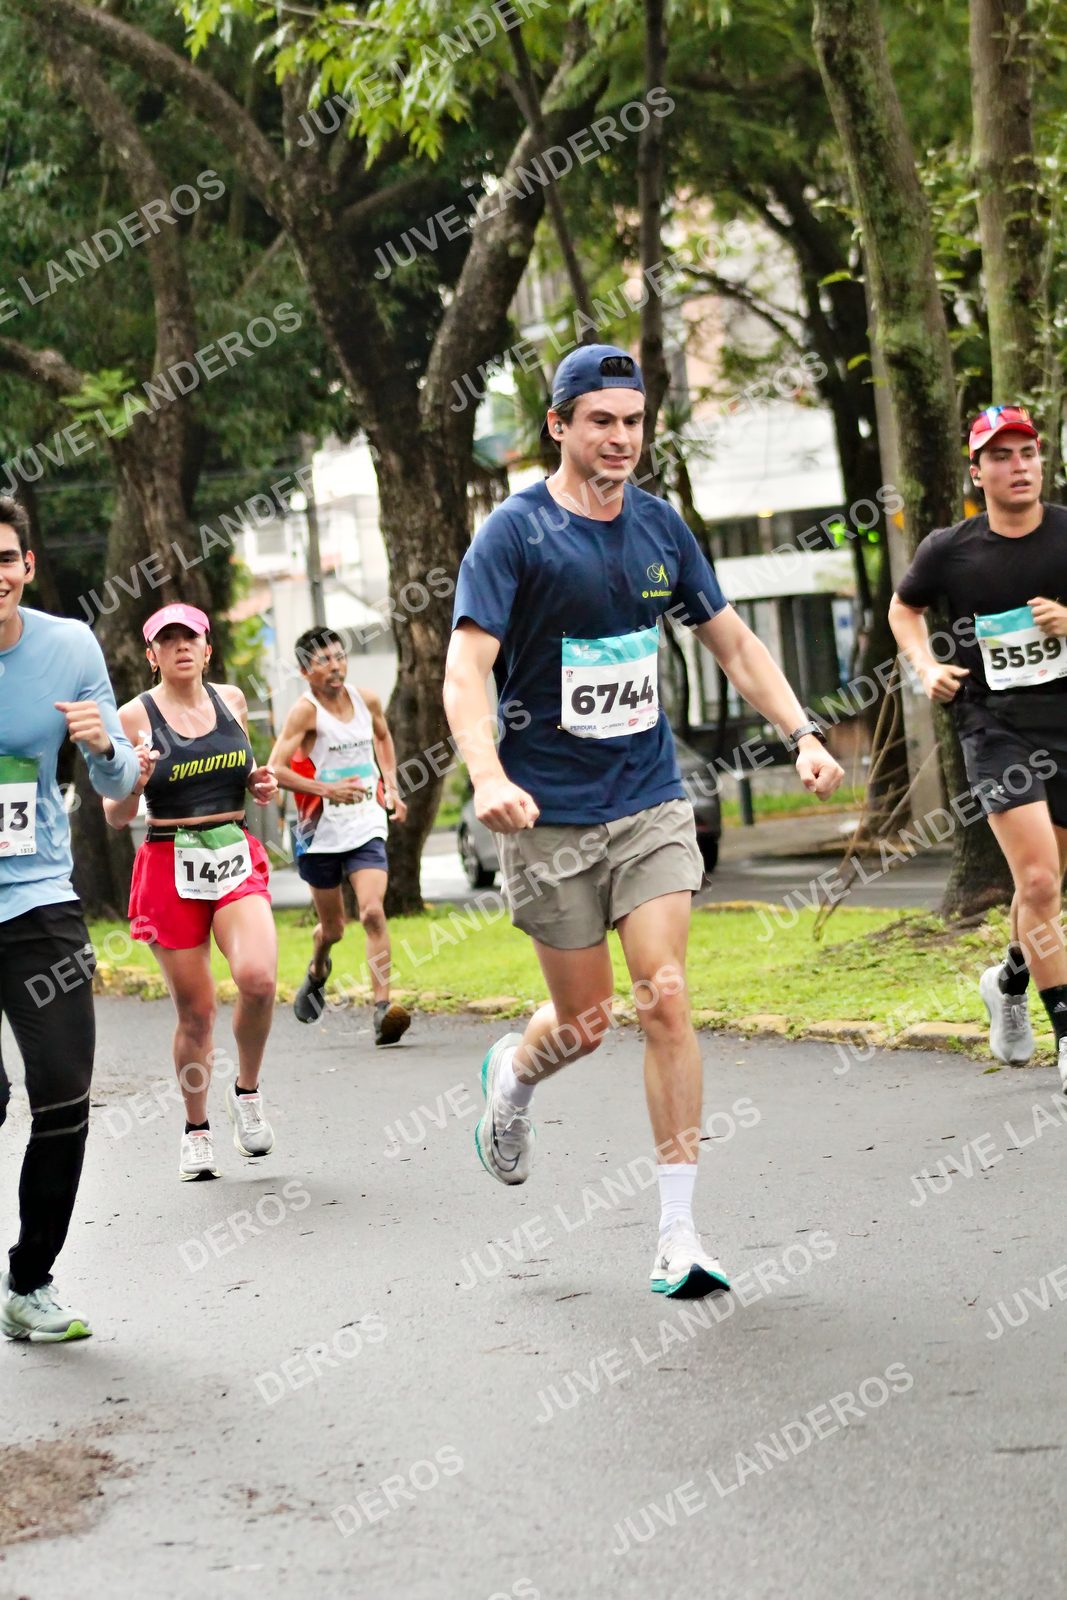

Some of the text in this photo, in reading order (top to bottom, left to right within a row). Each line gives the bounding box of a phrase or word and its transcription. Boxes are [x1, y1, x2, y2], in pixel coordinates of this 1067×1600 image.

[989, 637, 1062, 670] 5559
[571, 675, 654, 716] 6744
[169, 749, 246, 782] 3VOLUTION
[183, 854, 246, 883] 1422
